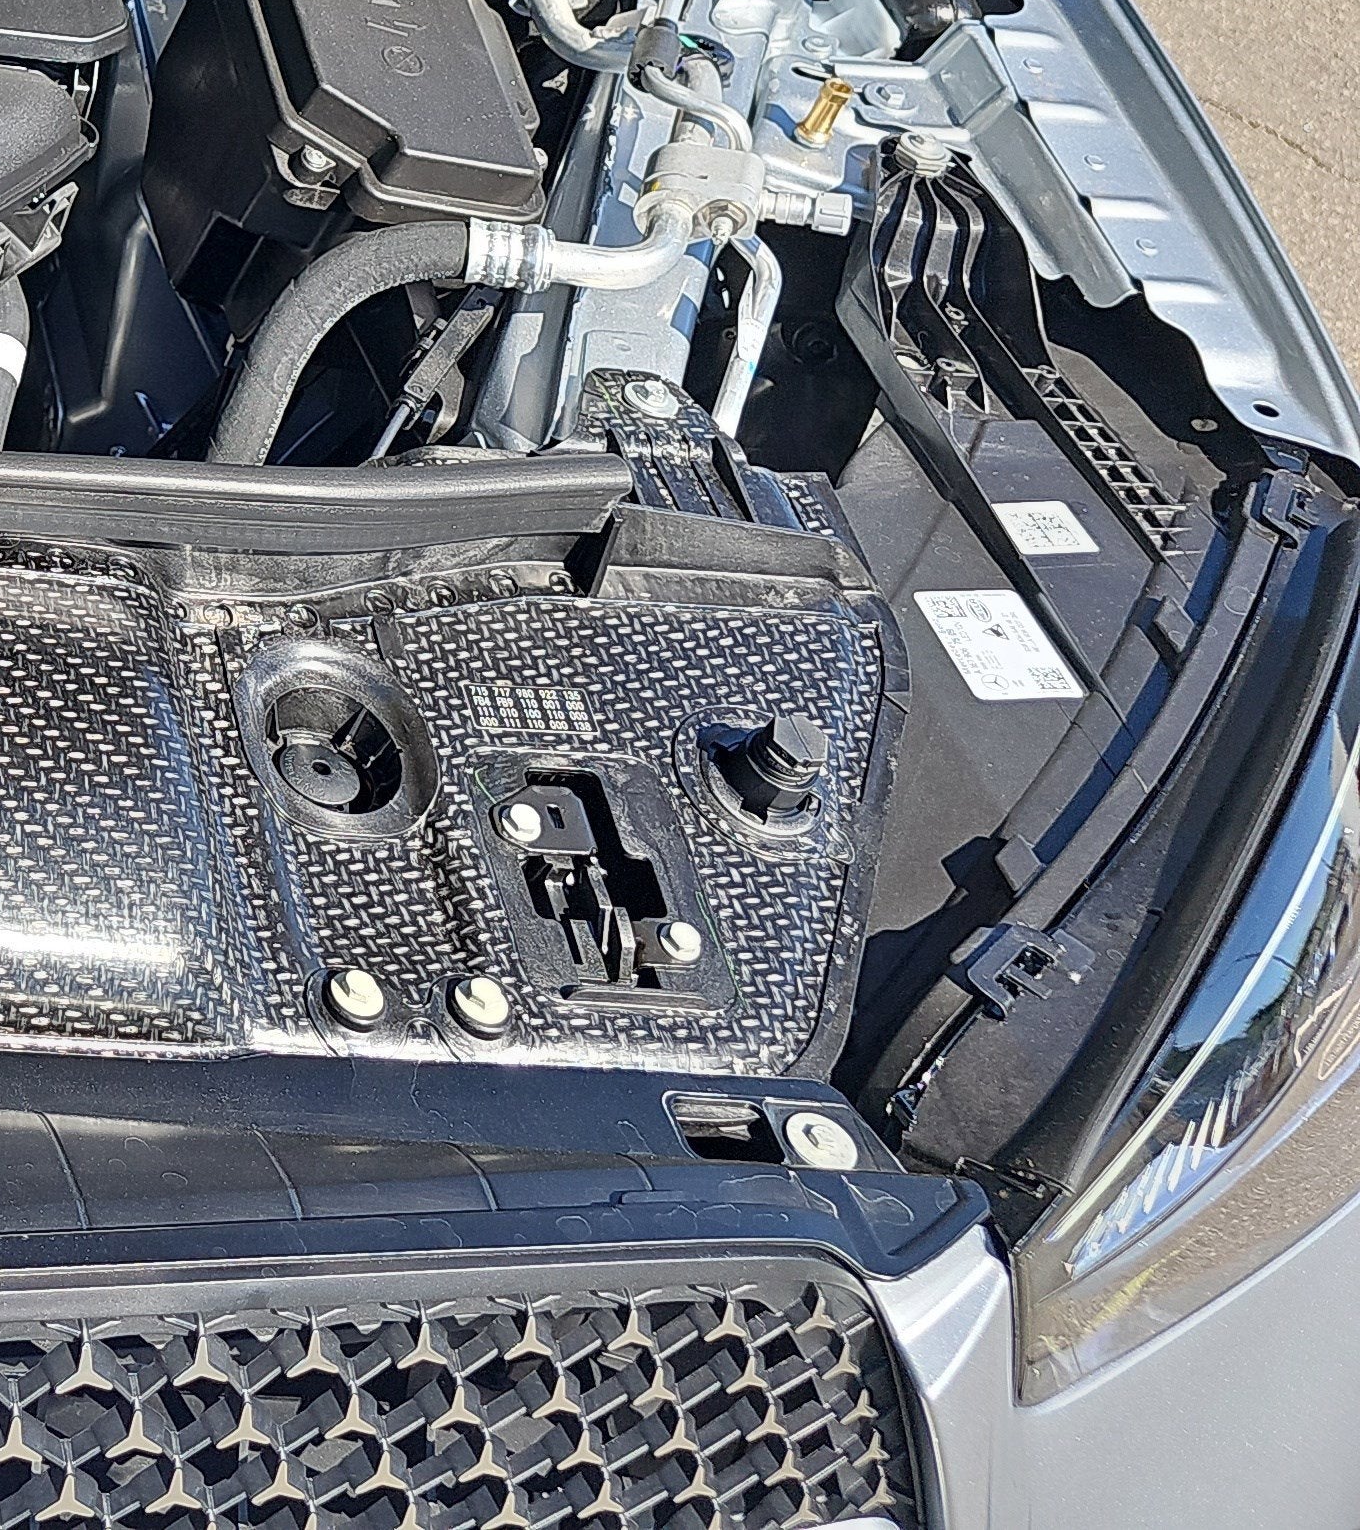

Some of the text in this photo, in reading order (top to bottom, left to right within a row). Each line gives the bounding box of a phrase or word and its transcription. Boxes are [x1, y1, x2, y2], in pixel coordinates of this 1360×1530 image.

[469, 686, 580, 700] 715 717 980 922 135
[473, 696, 584, 710] FB4 FB9 110 001 000
[477, 707, 588, 720] 111 010 100 110 000
[480, 717, 498, 726] 000
[503, 718, 521, 727] 111
[527, 719, 545, 729] 110
[549, 720, 568, 730] 000
